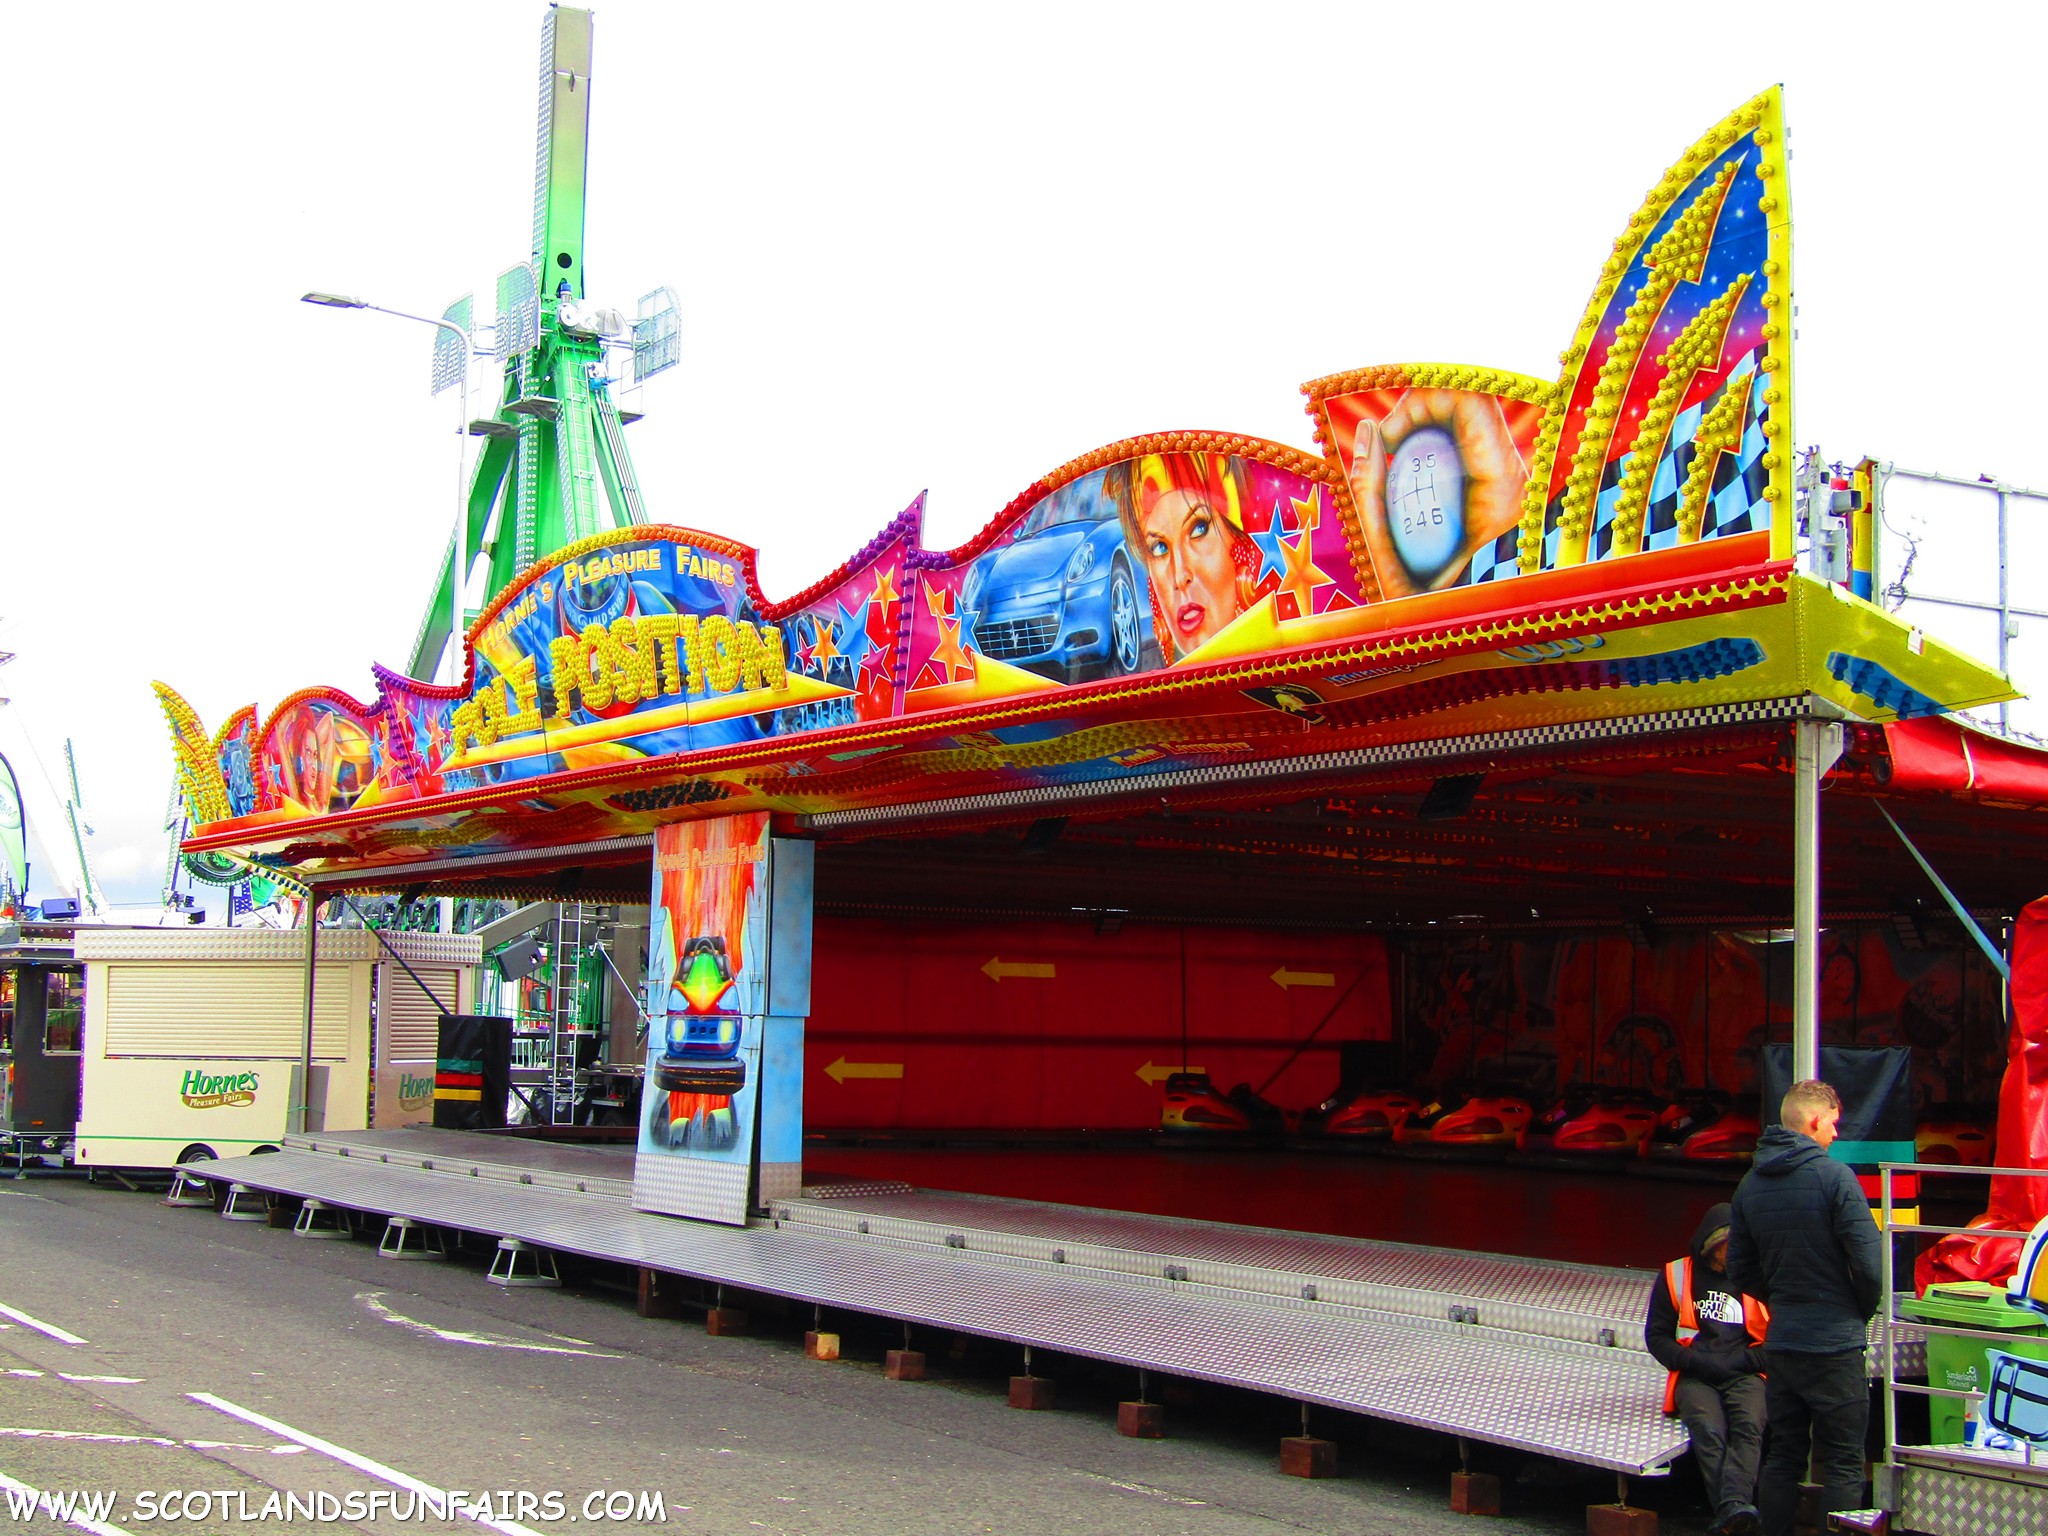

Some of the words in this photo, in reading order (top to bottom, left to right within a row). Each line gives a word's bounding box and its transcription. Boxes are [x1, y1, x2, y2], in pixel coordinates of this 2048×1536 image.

[1412, 457, 1420, 472] 3
[1426, 453, 1435, 468] 5
[1404, 517, 1413, 534] 2
[1416, 511, 1427, 526] 4
[1431, 508, 1443, 524] 6
[480, 580, 553, 656] HORNE'S
[563, 548, 661, 590] PLEASURE
[676, 546, 735, 587] FAIRS
[451, 654, 542, 758] POLE
[549, 613, 788, 718] POSITION
[1707, 1290, 1728, 1302] THE
[1700, 1309, 1724, 1321] FACE
[1945, 1369, 1977, 1382] Sunderland
